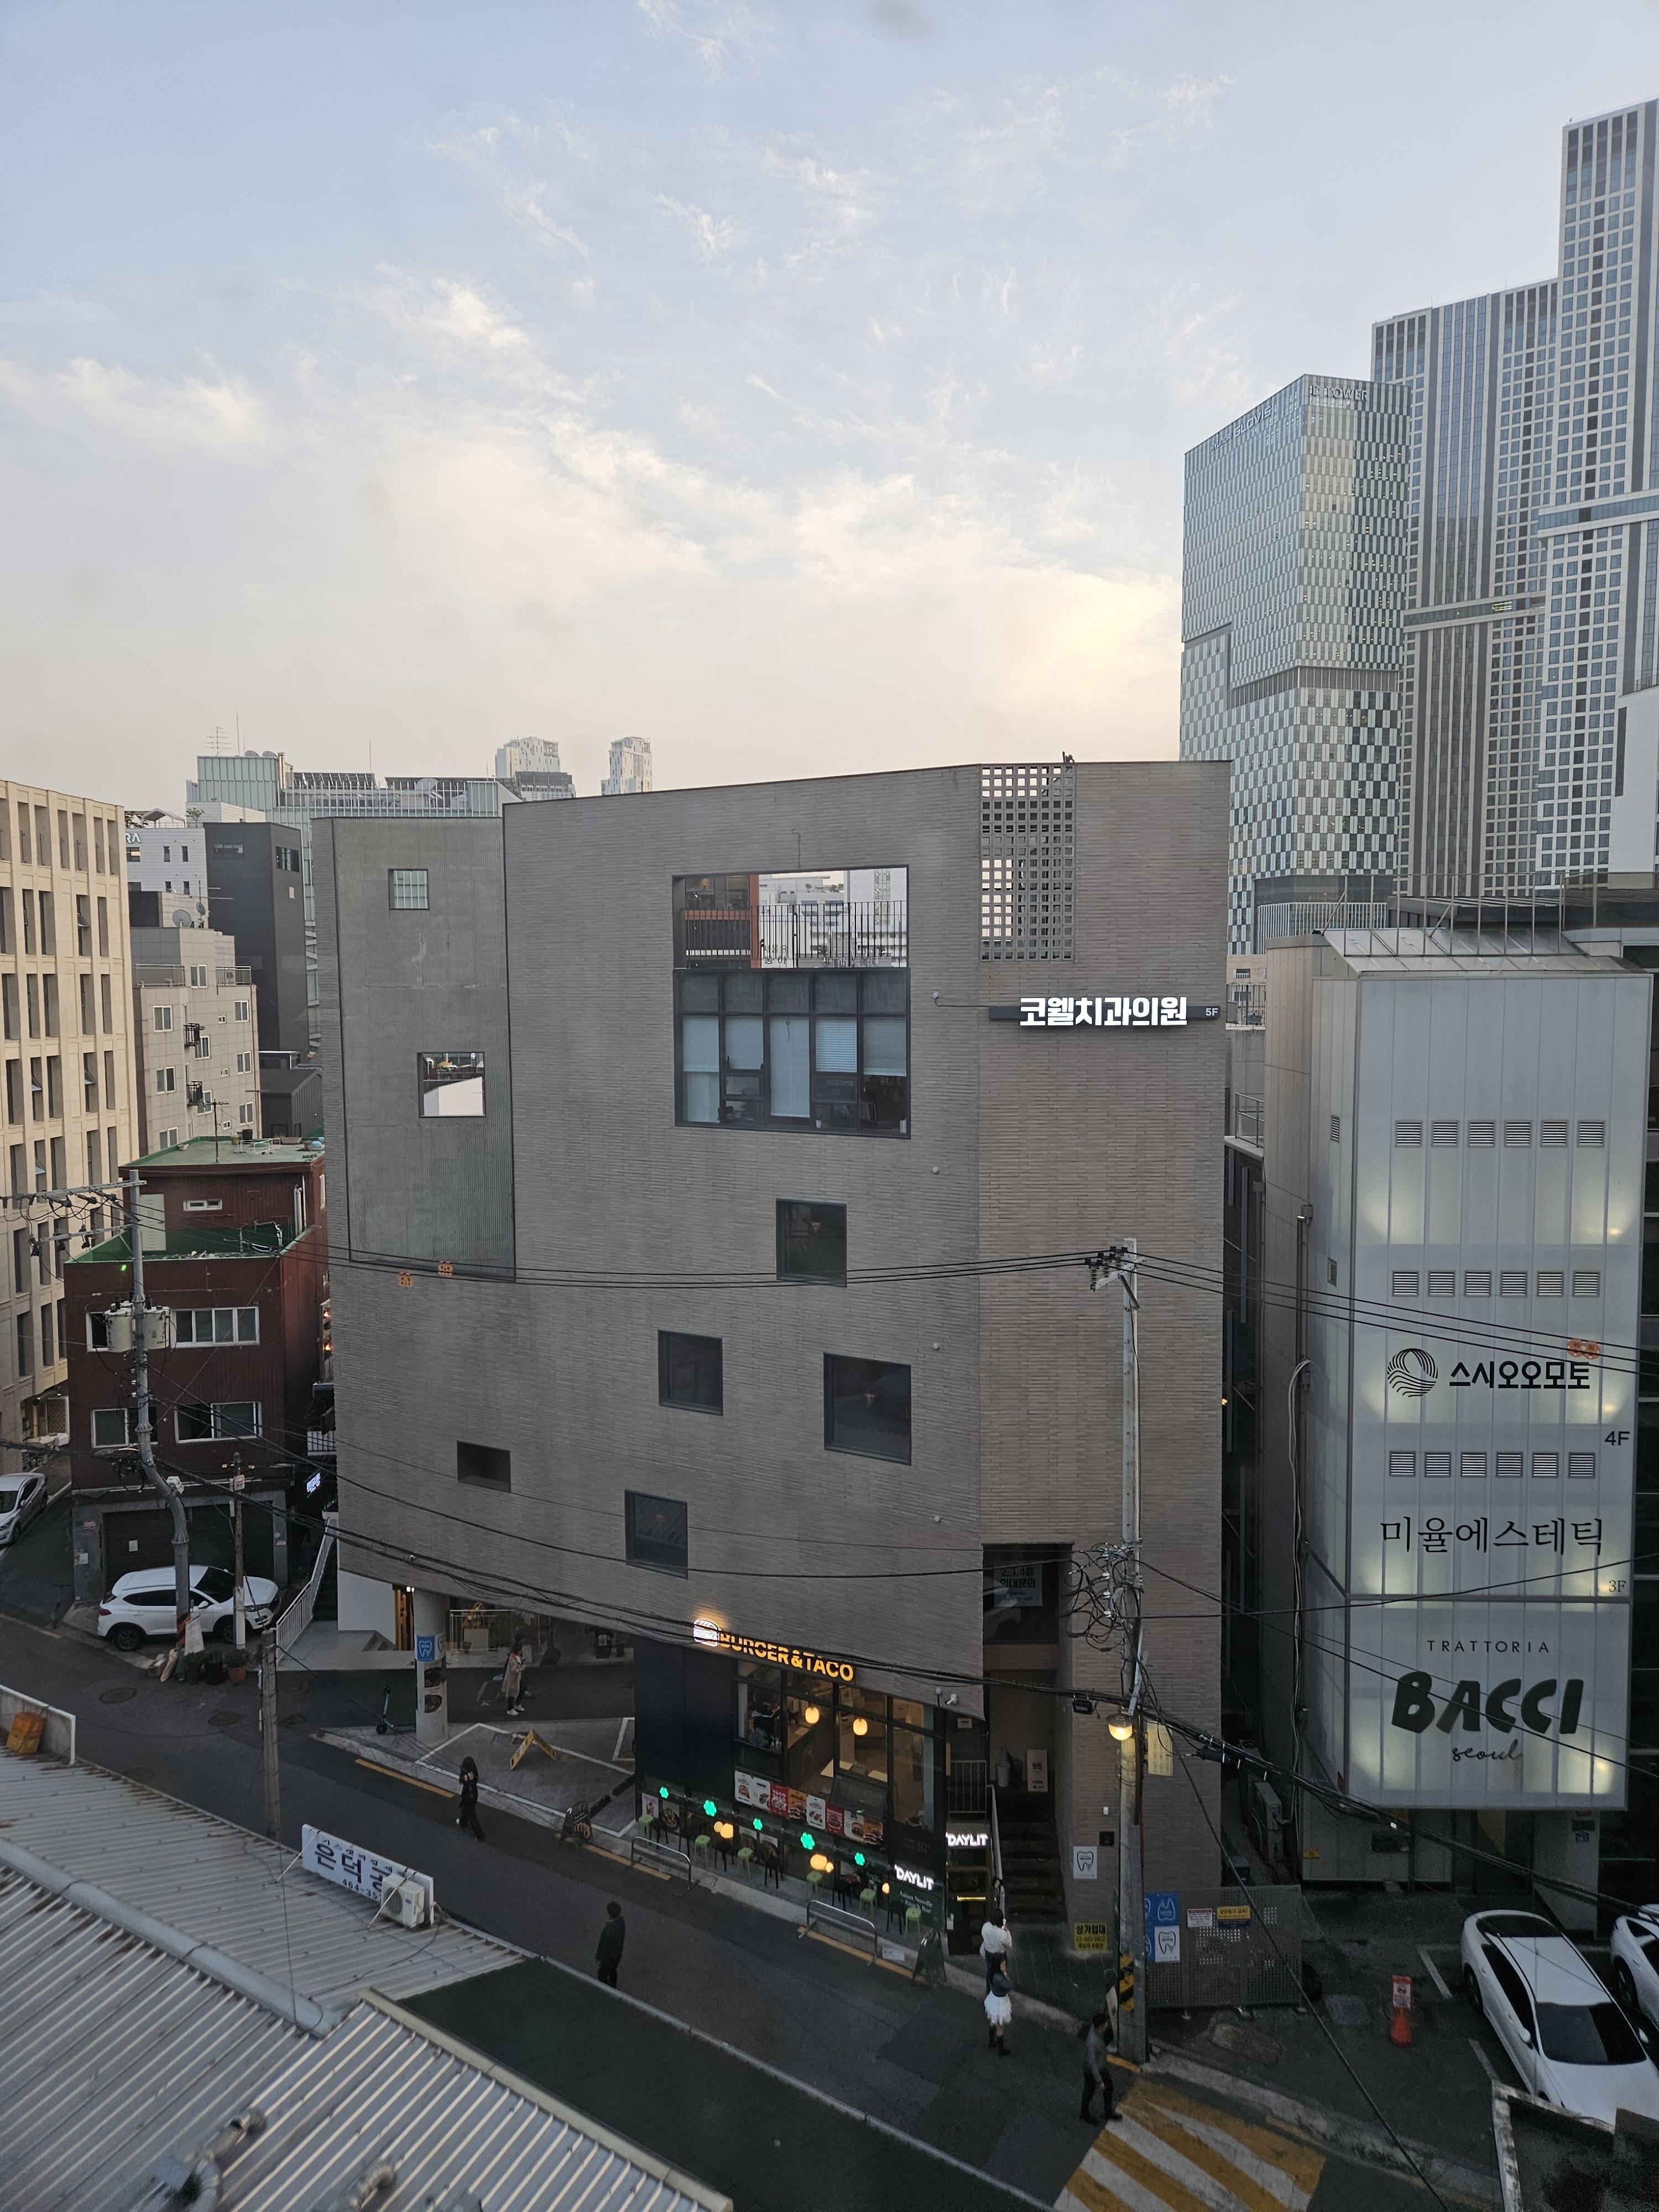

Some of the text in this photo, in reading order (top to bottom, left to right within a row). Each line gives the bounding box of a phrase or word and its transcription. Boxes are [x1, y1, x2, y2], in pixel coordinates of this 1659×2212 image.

[1313, 385, 1368, 401] D TOWER
[1211, 406, 1271, 452] HYUNDAI GLOVIS
[1020, 997, 1187, 1026] 코웰치과의원
[1206, 1008, 1218, 1016] 5F
[1449, 1360, 1590, 1389] 스시오오모토
[1605, 1431, 1630, 1446] 4F
[1380, 1516, 1602, 1556] 미율에스테틱
[1000, 1577, 1036, 1588] 임대문의
[1609, 1580, 1626, 1593] 3F
[1427, 1640, 1549, 1653] TRATTORIA
[719, 1632, 853, 1682] BURGER&TACO
[1391, 1671, 1584, 1735] BACCI
[1452, 1739, 1523, 1761] seoul
[772, 1789, 786, 1798] TACO
[946, 1833, 988, 1846] DAYLIT
[895, 1865, 934, 1890] DAYLIT
[899, 1891, 933, 1907] Asian Noodle
[1076, 1924, 1106, 1934] 상가임대
